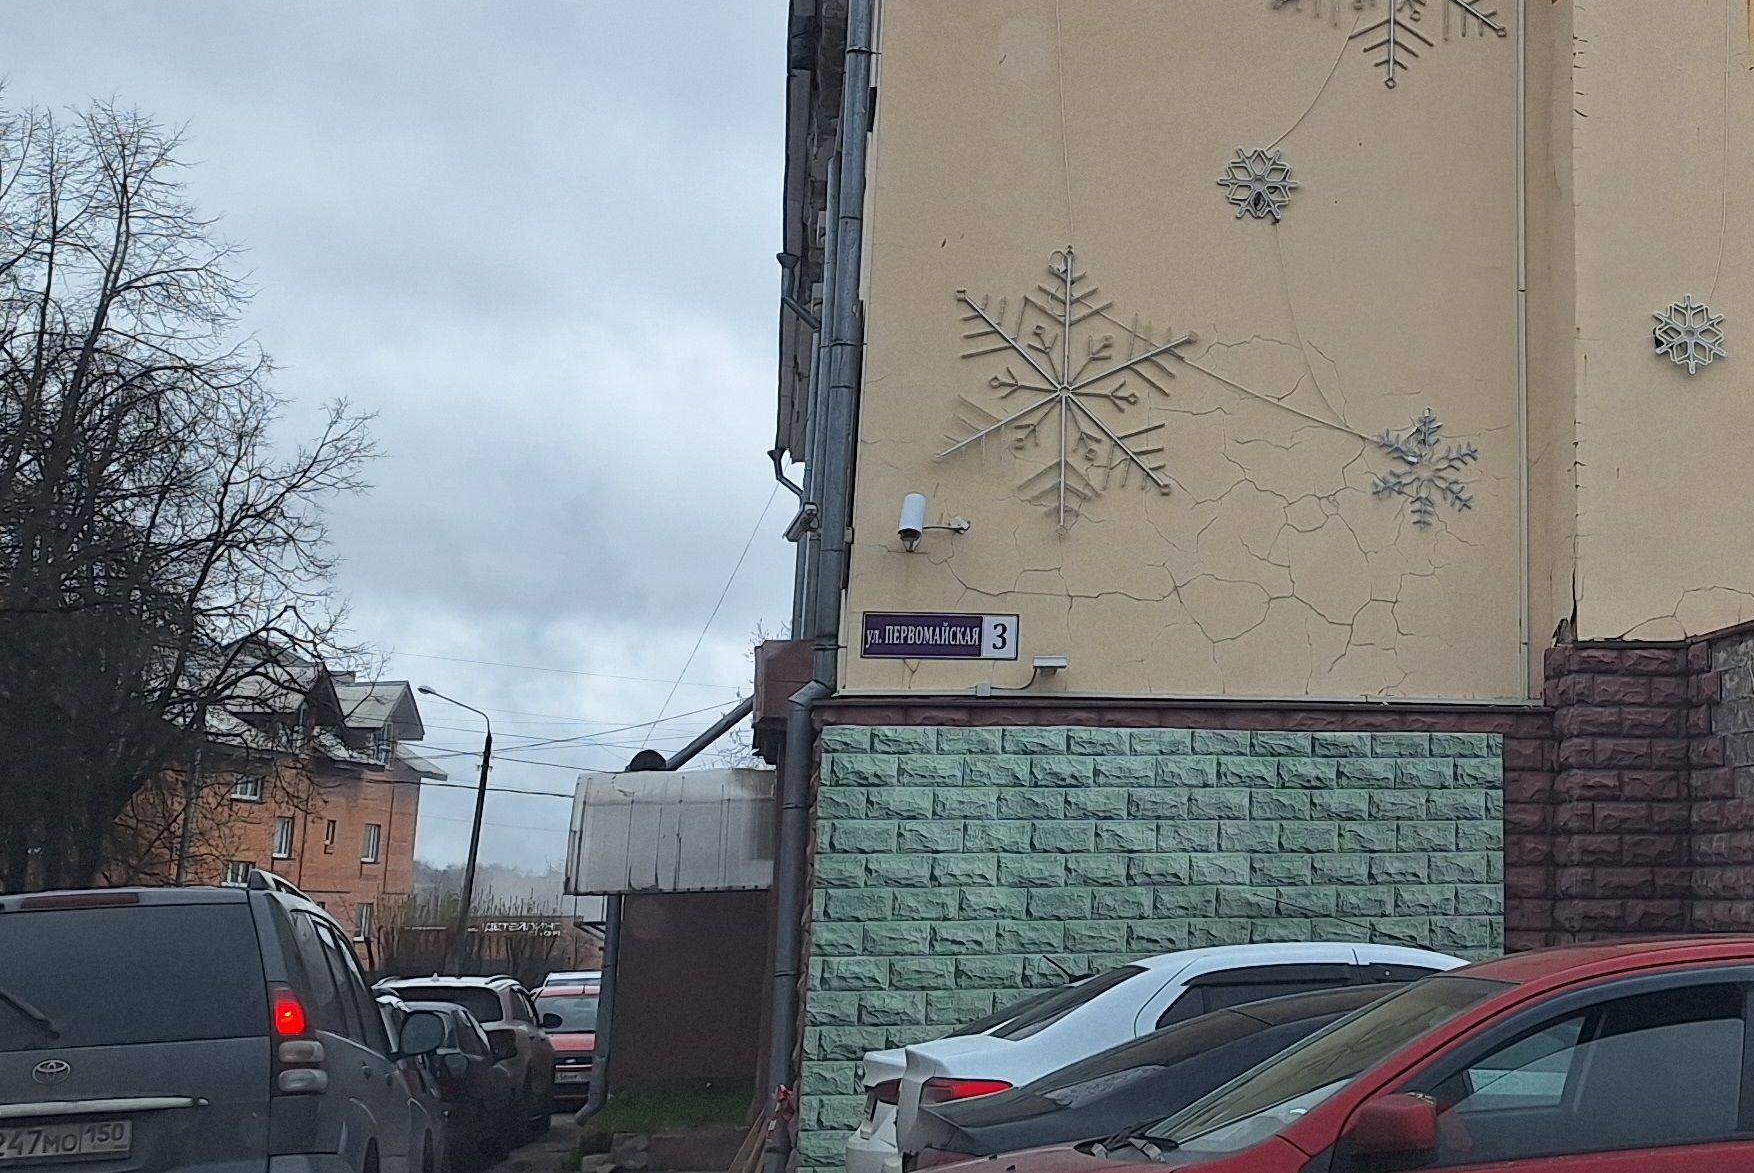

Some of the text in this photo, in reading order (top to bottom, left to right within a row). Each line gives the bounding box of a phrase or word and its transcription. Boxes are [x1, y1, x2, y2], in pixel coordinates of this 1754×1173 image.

[866, 621, 1008, 650] ул. ПЕРВОМАЙСКАЯ 3
[84, 1122, 125, 1143] 150
